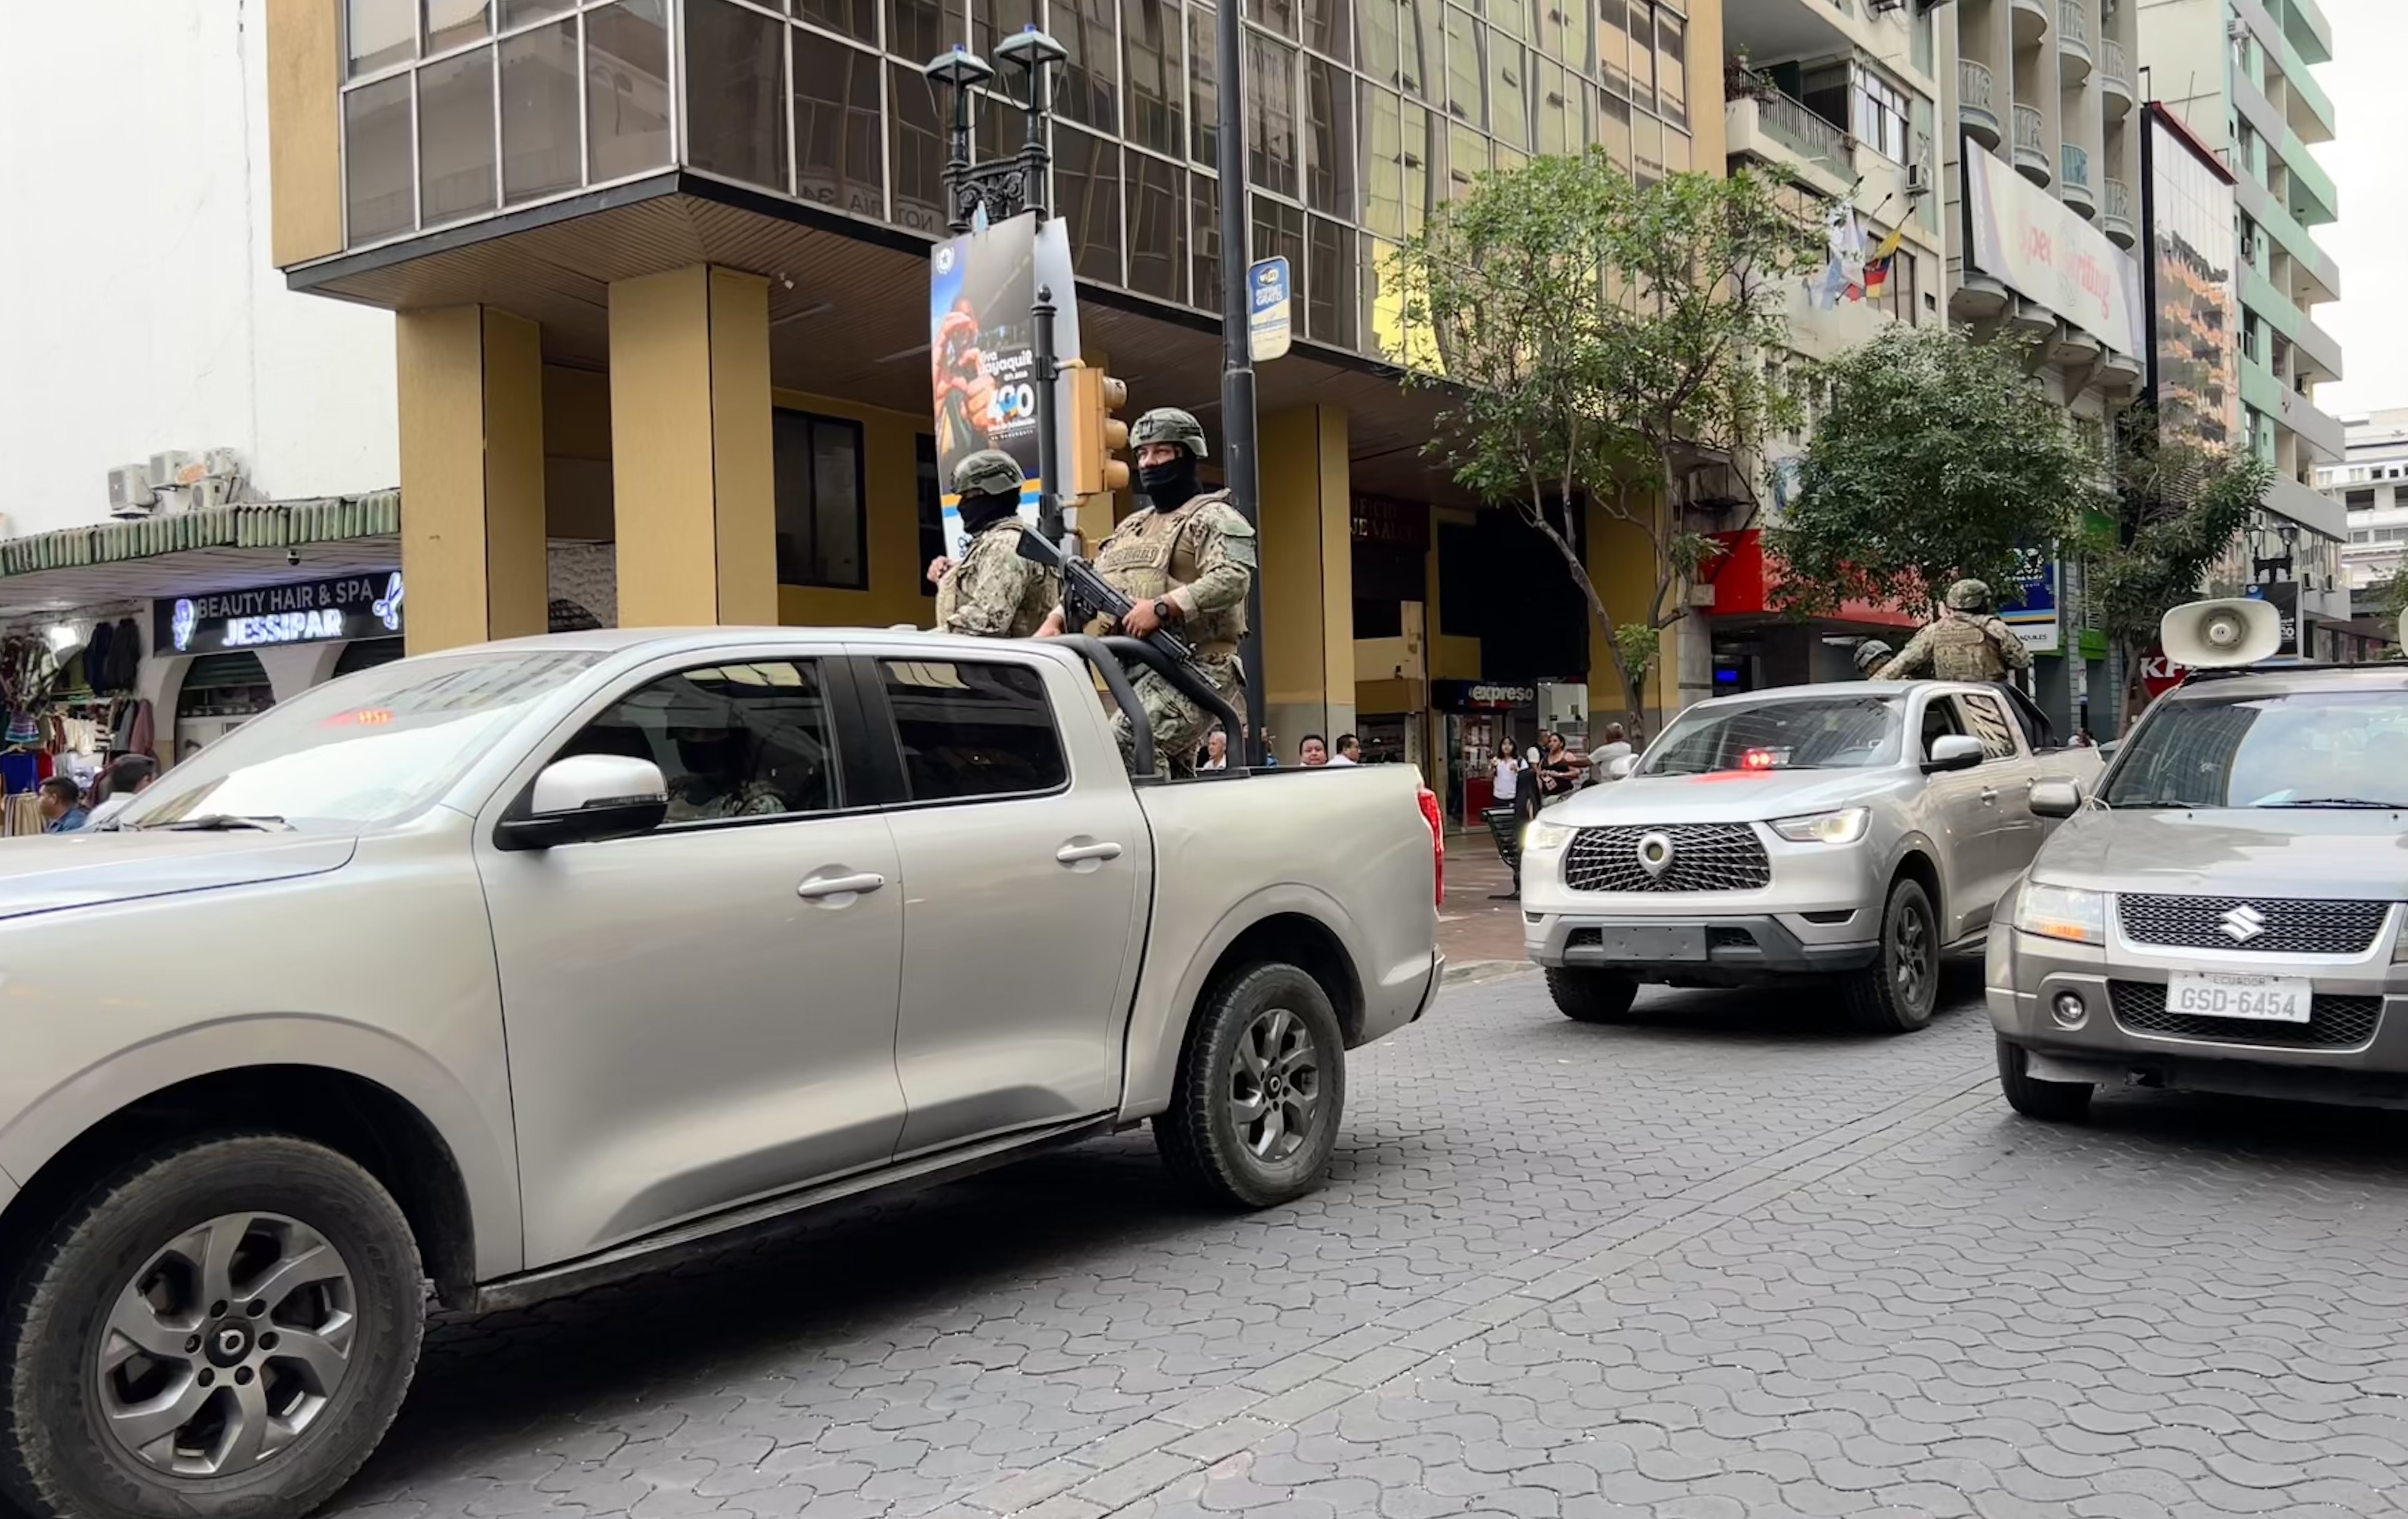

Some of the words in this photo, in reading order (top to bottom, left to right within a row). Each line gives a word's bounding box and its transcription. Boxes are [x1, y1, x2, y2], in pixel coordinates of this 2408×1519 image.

[197, 592, 266, 618] BEAUTY
[271, 586, 312, 611] HAIR
[319, 584, 331, 606] &
[336, 578, 374, 603] SPA
[222, 609, 342, 646] JESSIPAR
[2140, 656, 2188, 679] KF
[1473, 685, 1533, 707] expreso
[2213, 975, 2265, 986] ECUADOR
[2180, 987, 2296, 1016] GSD-6454
